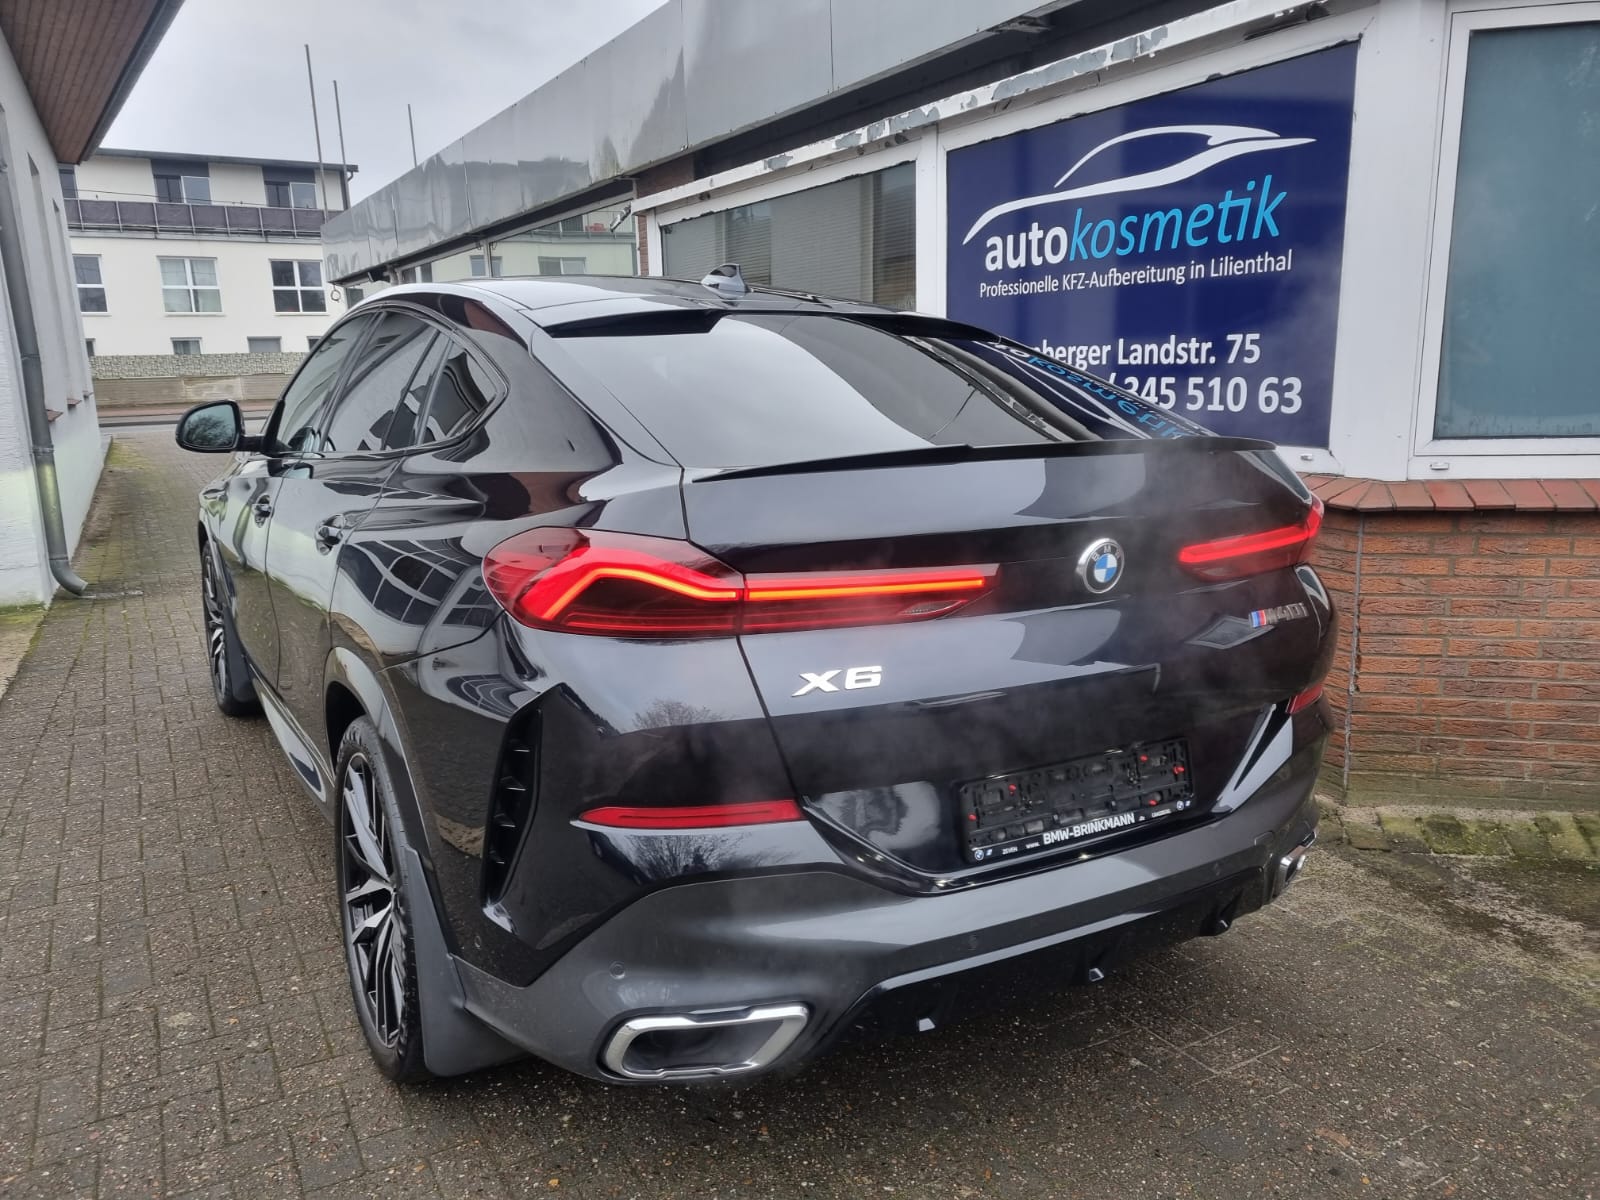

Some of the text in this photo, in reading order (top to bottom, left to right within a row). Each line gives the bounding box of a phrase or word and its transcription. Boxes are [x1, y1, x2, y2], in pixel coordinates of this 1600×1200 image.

[985, 174, 1288, 272] autokosmetik
[980, 249, 1293, 298] Professionelle KFZ-Aufbereitung in Lilienthal
[1117, 334, 1217, 365] Landstr.
[1226, 333, 1261, 365] 75
[1186, 377, 1248, 411] 510
[1258, 376, 1303, 414] 63
[790, 665, 883, 698] X6
[1043, 811, 1136, 845] BMW-BRINKMANN
